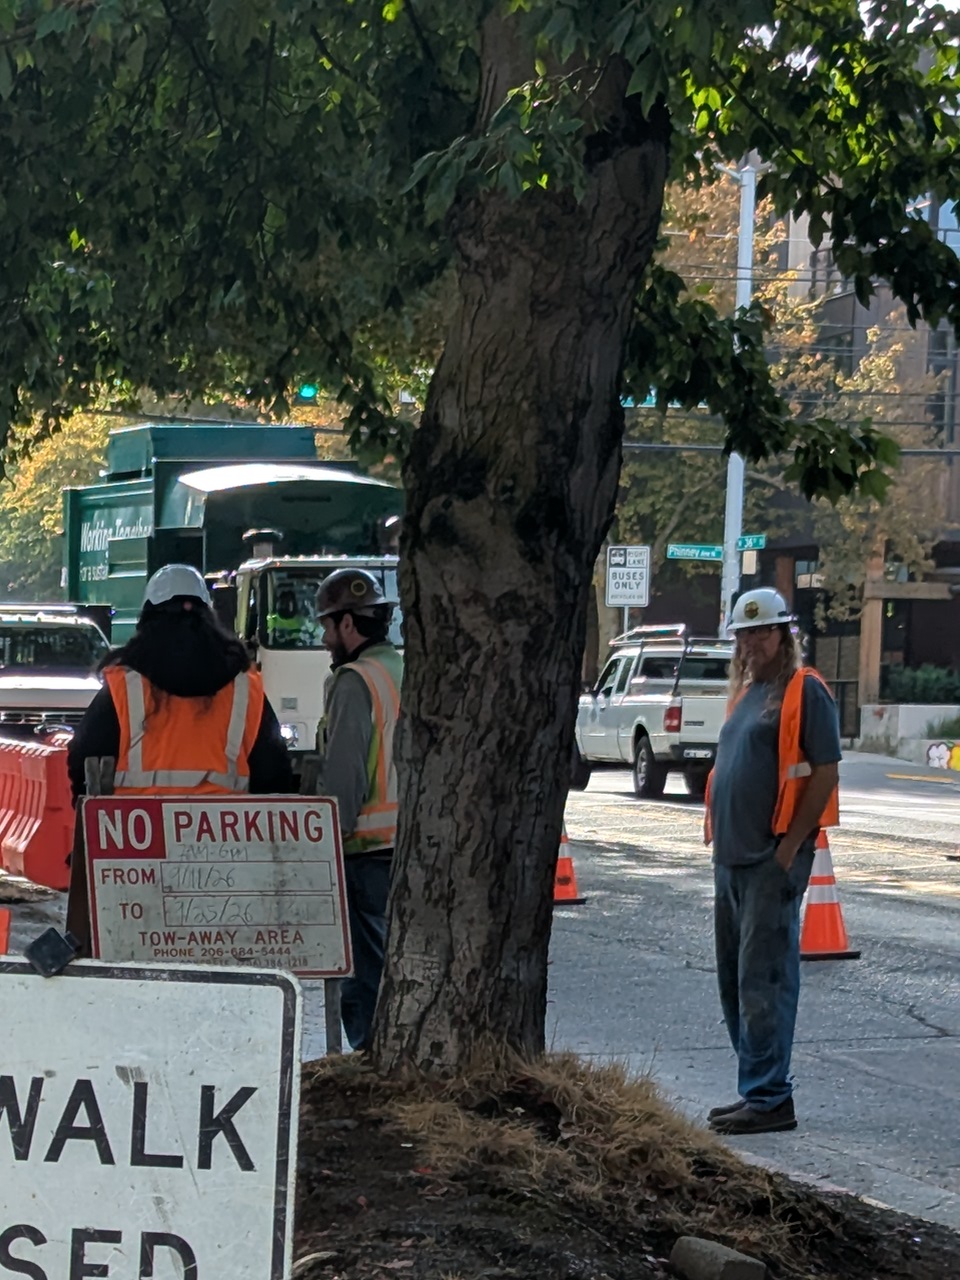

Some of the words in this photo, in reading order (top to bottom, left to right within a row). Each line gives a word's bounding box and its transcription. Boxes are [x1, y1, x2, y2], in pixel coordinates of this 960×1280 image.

[628, 558, 646, 566] LANE
[611, 571, 645, 581] BUSES
[614, 581, 641, 590] ONLY
[97, 808, 153, 851] NO
[174, 810, 324, 844] PARKING
[100, 867, 156, 885] FROM
[119, 902, 144, 920] TO
[138, 931, 238, 946] TOW-AWAY
[254, 930, 305, 945] AREA
[153, 947, 196, 958] PHONE
